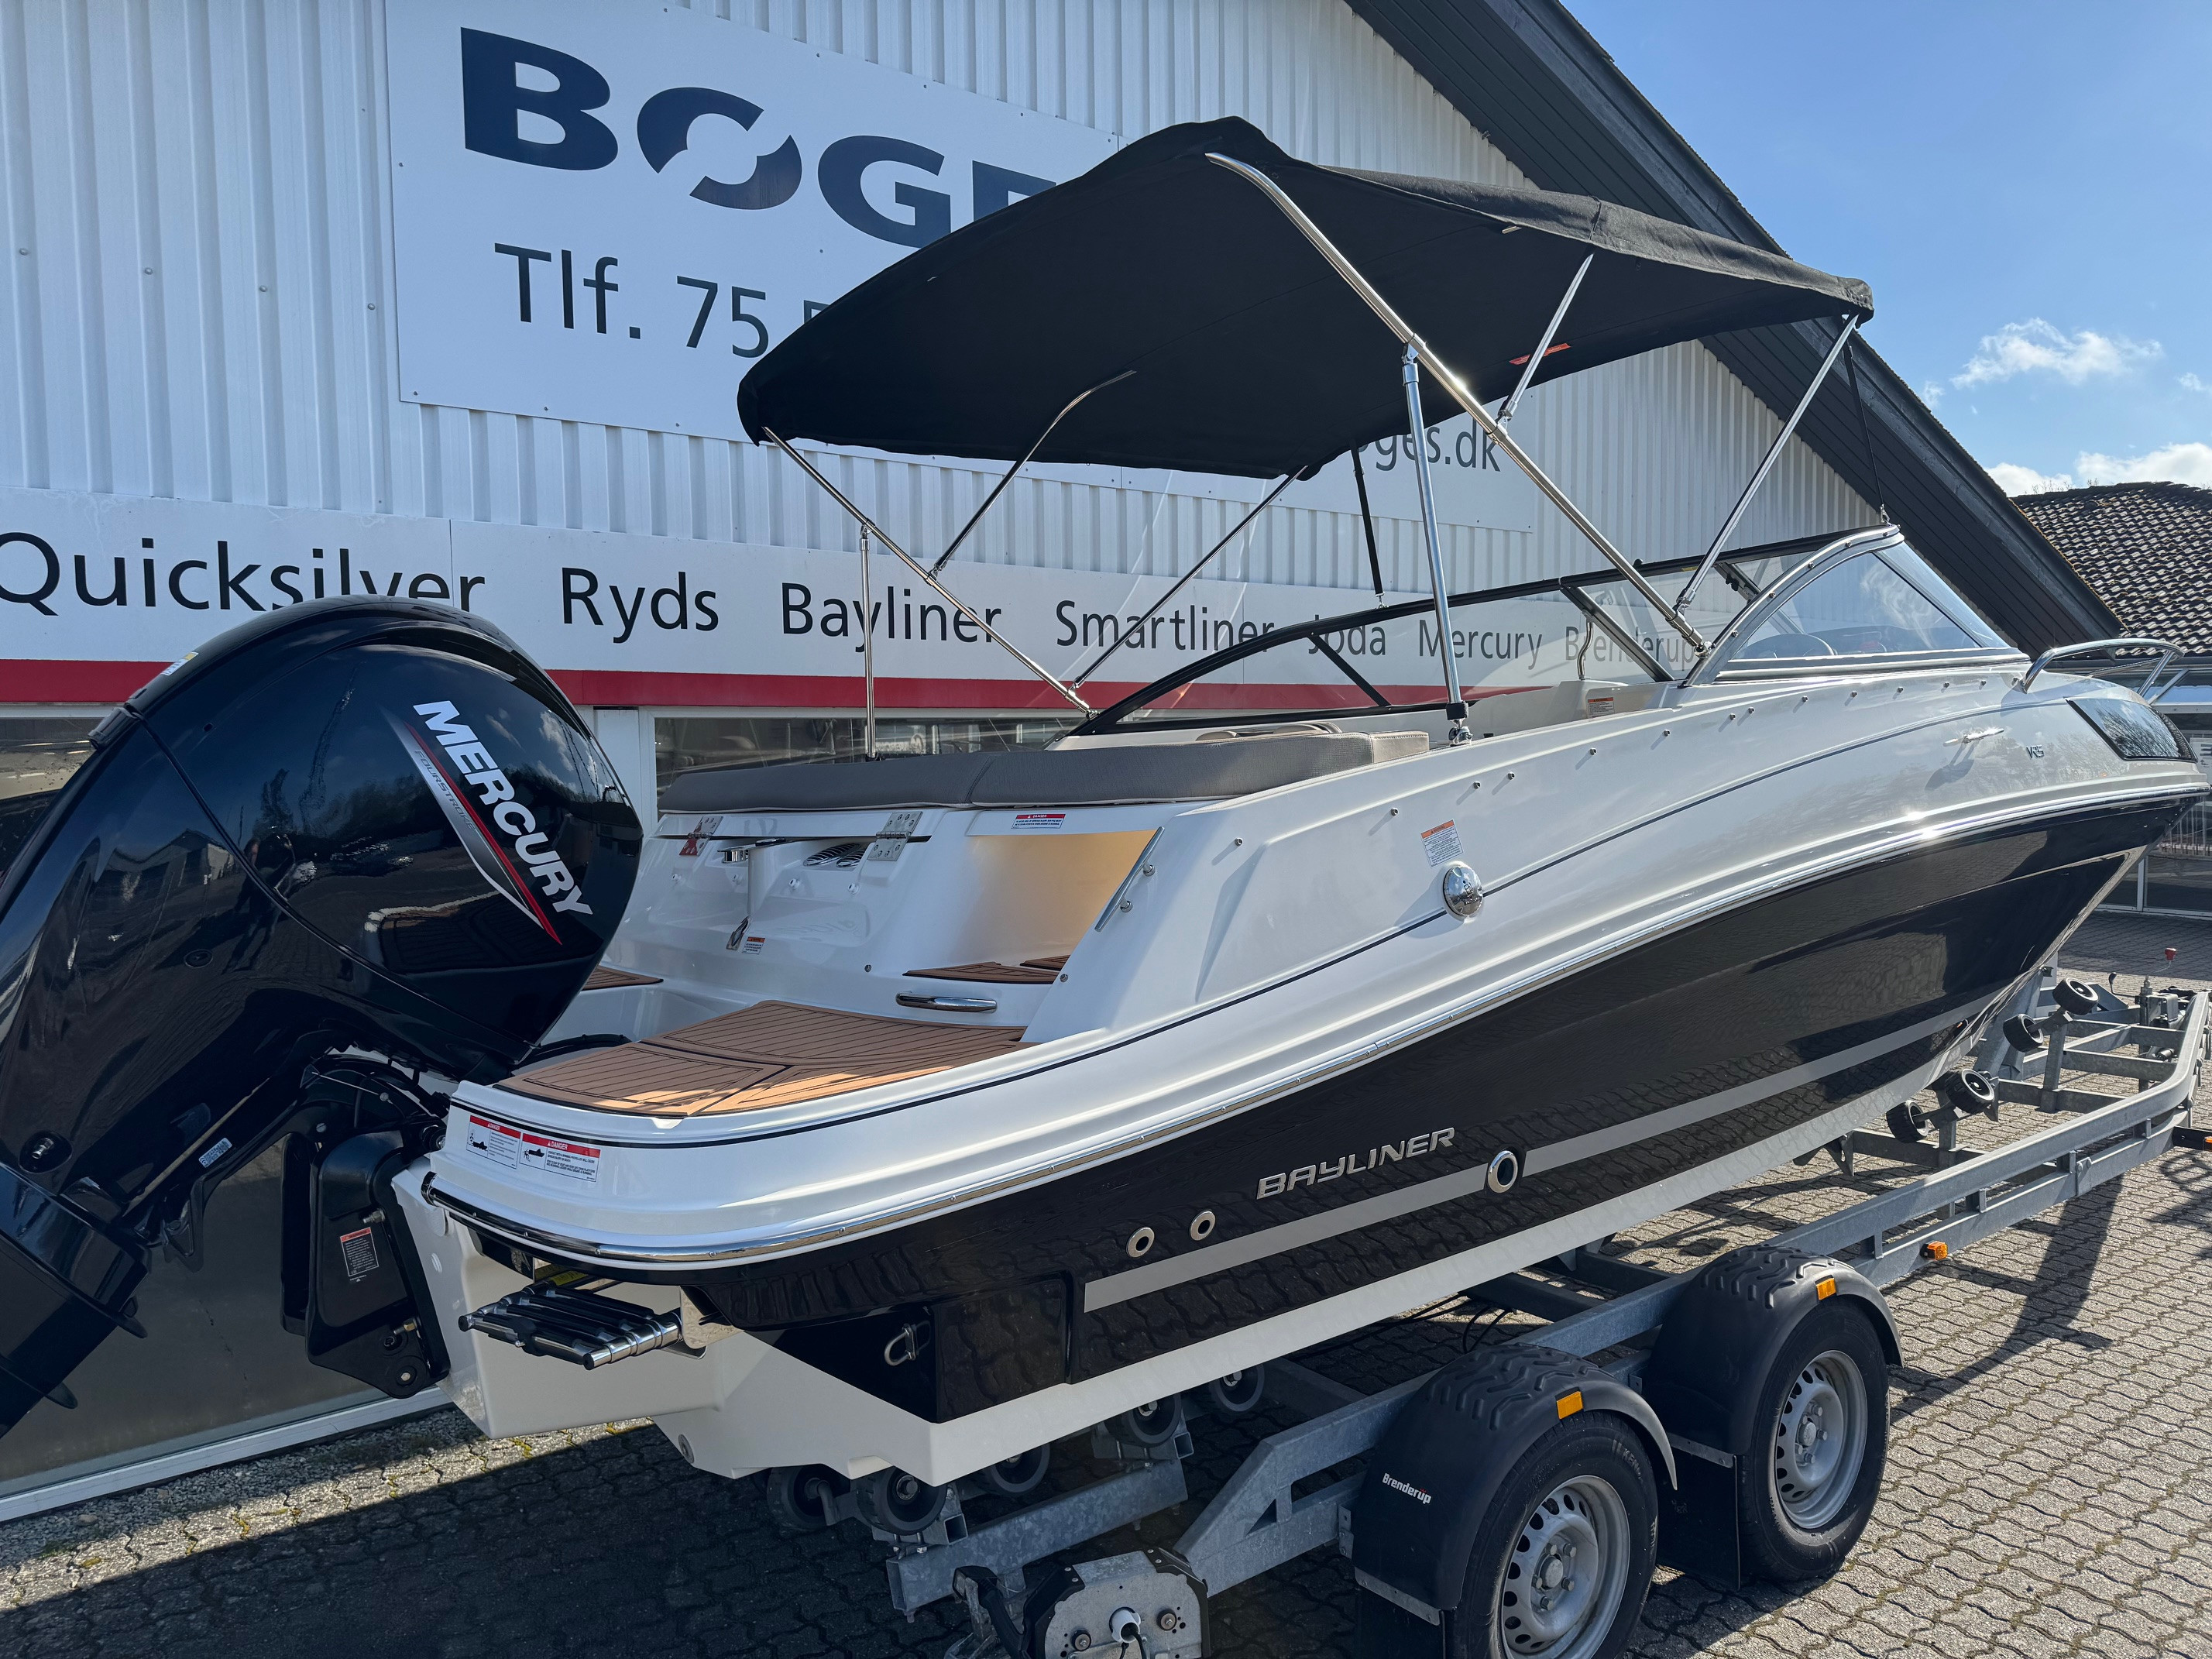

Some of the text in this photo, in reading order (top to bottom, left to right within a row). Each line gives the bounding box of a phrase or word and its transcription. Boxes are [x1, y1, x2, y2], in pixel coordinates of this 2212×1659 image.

[494, 242, 769, 358] Tlf. 75
[1358, 420, 1501, 472] ges.dk
[0, 532, 486, 617] Quicksilver
[562, 567, 719, 644] Ryds
[781, 582, 1001, 653] Bayliner
[1056, 599, 1275, 653] Smartliner
[1419, 620, 1543, 670] Mercury
[413, 700, 593, 915] MERCURY
[415, 750, 476, 830] FOURSTROKE
[551, 1141, 568, 1150] DANGER
[1256, 1127, 1455, 1200] BAYLINER
[1382, 1472, 1432, 1504] Brenderup
